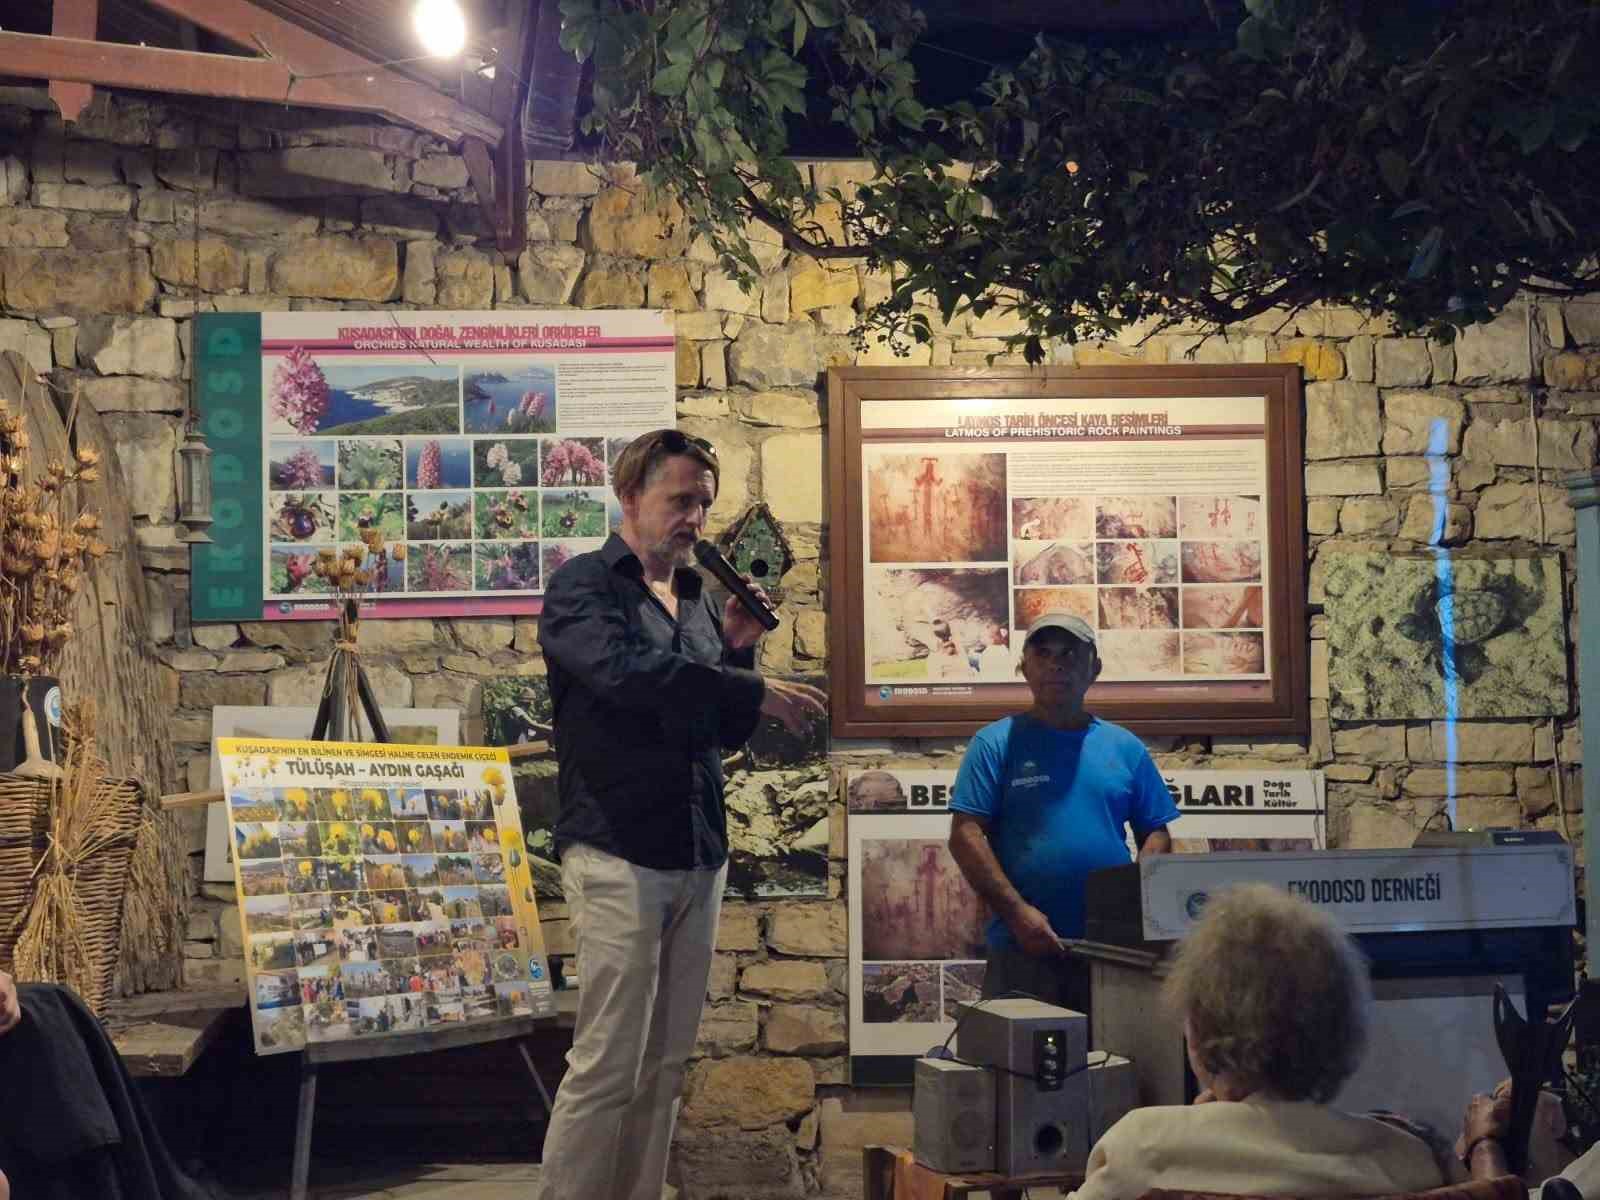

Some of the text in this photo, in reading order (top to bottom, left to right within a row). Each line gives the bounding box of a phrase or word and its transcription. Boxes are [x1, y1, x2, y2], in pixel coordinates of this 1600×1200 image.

[353, 339, 406, 350] ORCHIDS
[464, 339, 509, 349] WEALTH
[512, 339, 527, 349] OF
[1080, 412, 1109, 427] KAYA
[945, 423, 1182, 438] LATMOS OF PREHISTORIC ROCK PAINTINGS
[207, 327, 243, 609] EKODOSD
[286, 757, 355, 779] TÜLÜŞAH
[369, 763, 412, 777] AYDIN
[415, 761, 465, 781] GAŞAĞI
[1165, 776, 1254, 807] ĞLARI
[1263, 789, 1291, 798] Tarih
[1264, 799, 1298, 808] Kültür
[1371, 872, 1441, 903] DERNEĞİ
